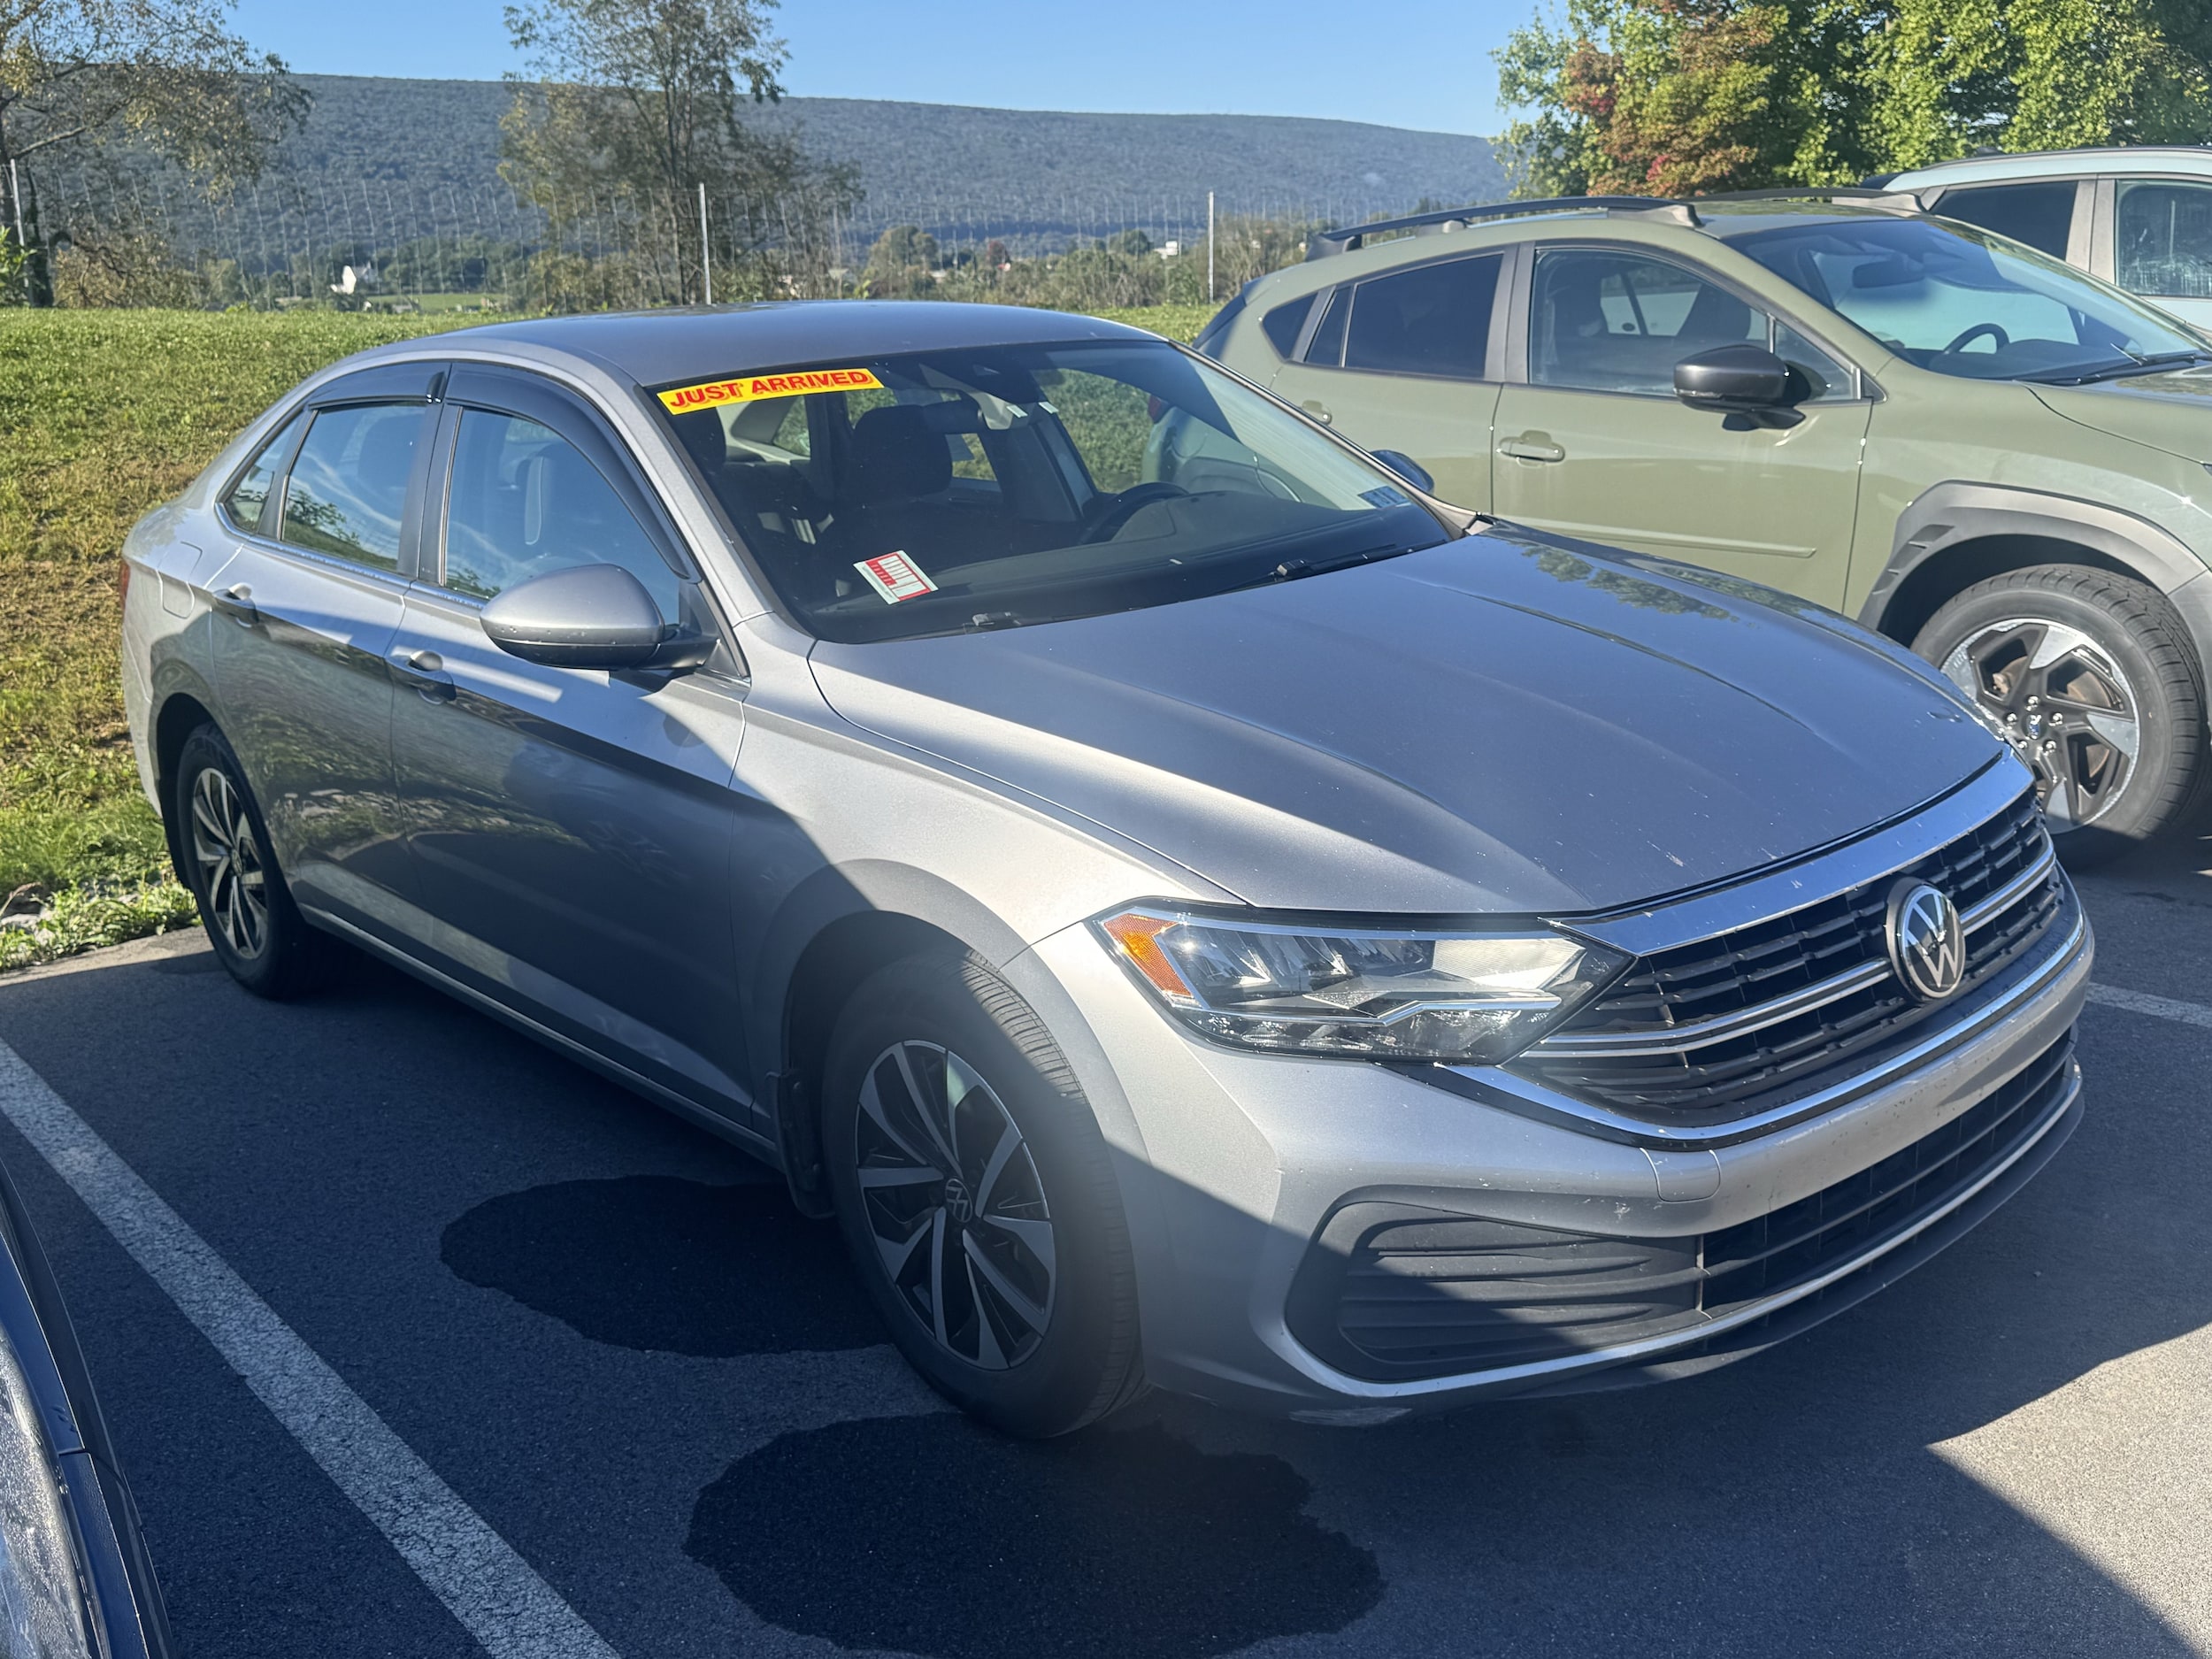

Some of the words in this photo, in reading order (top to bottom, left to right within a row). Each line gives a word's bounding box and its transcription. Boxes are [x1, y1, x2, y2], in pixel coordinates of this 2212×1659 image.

[670, 382, 743, 408] JUST
[751, 371, 873, 395] ARRIVED
[1903, 887, 1963, 993] VW
